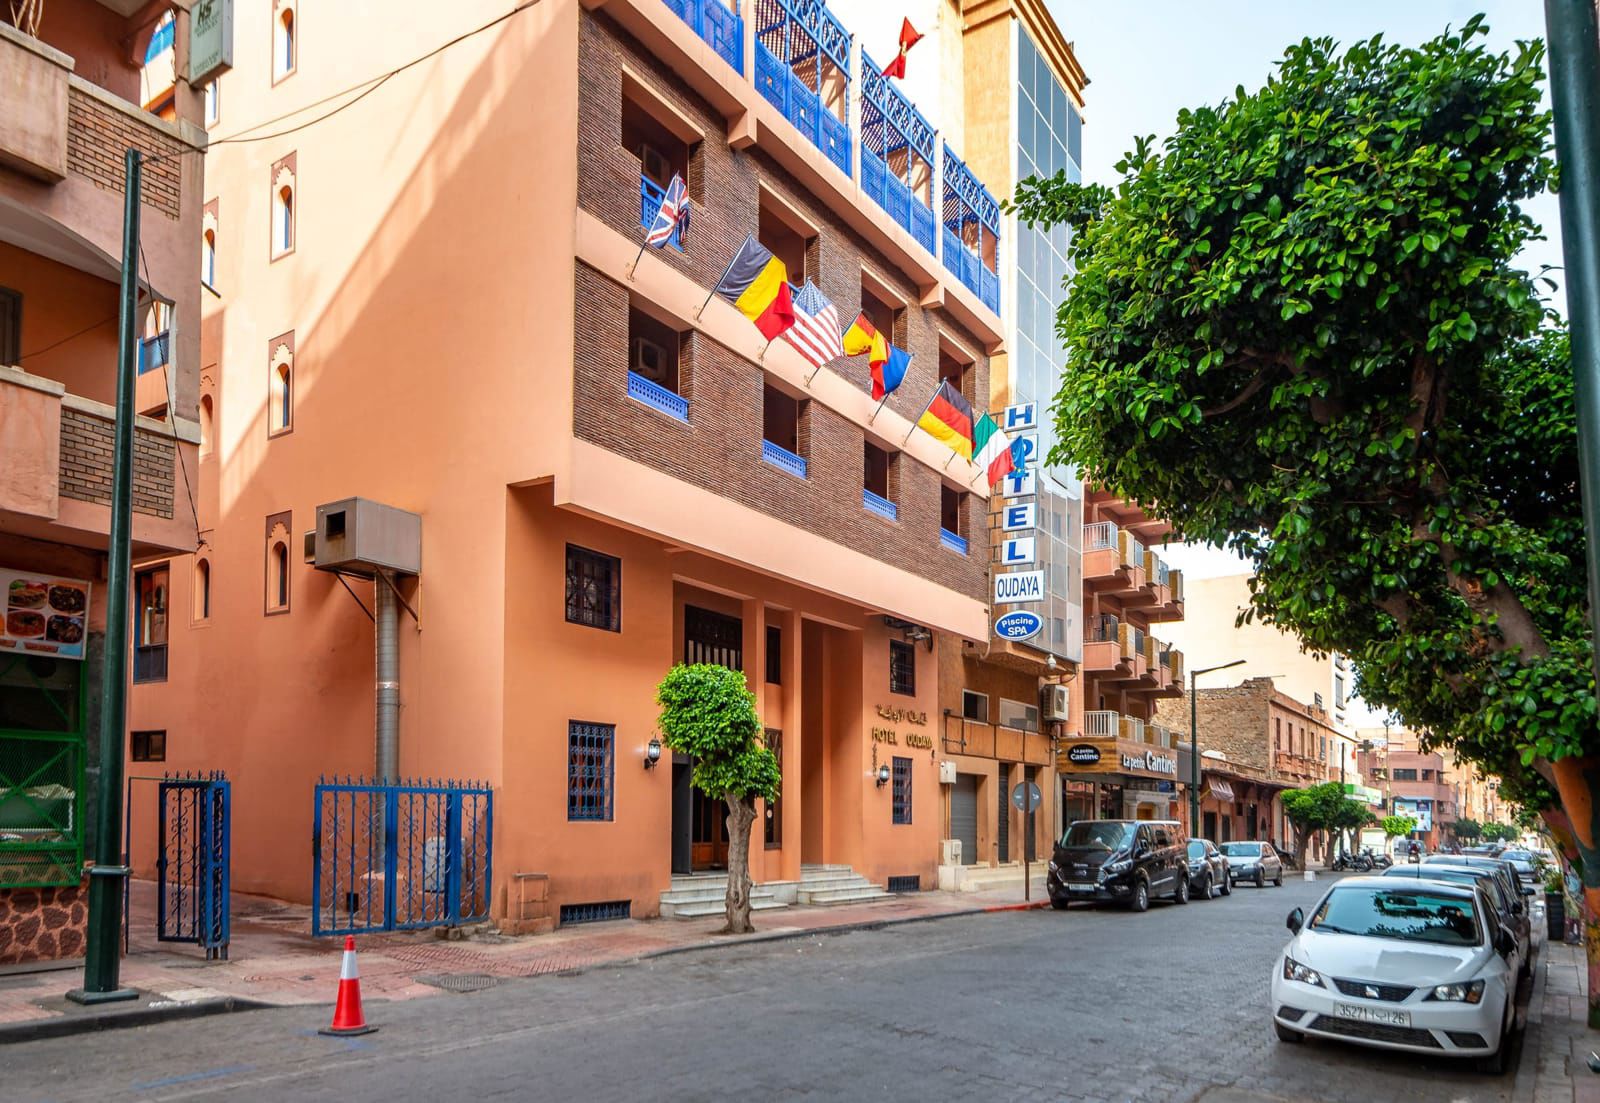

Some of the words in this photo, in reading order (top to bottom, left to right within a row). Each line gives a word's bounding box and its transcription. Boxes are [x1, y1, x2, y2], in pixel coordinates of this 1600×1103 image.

[997, 576, 1040, 598] OUDAYA
[1001, 616, 1034, 628] Piscine
[1007, 626, 1028, 636] SPA
[871, 727, 897, 746] HOTEL
[906, 734, 933, 750] OUDAYA
[1070, 753, 1099, 761] Cantine
[1122, 753, 1130, 768] La
[1130, 757, 1145, 771] petite
[1145, 750, 1176, 774] Cantine
